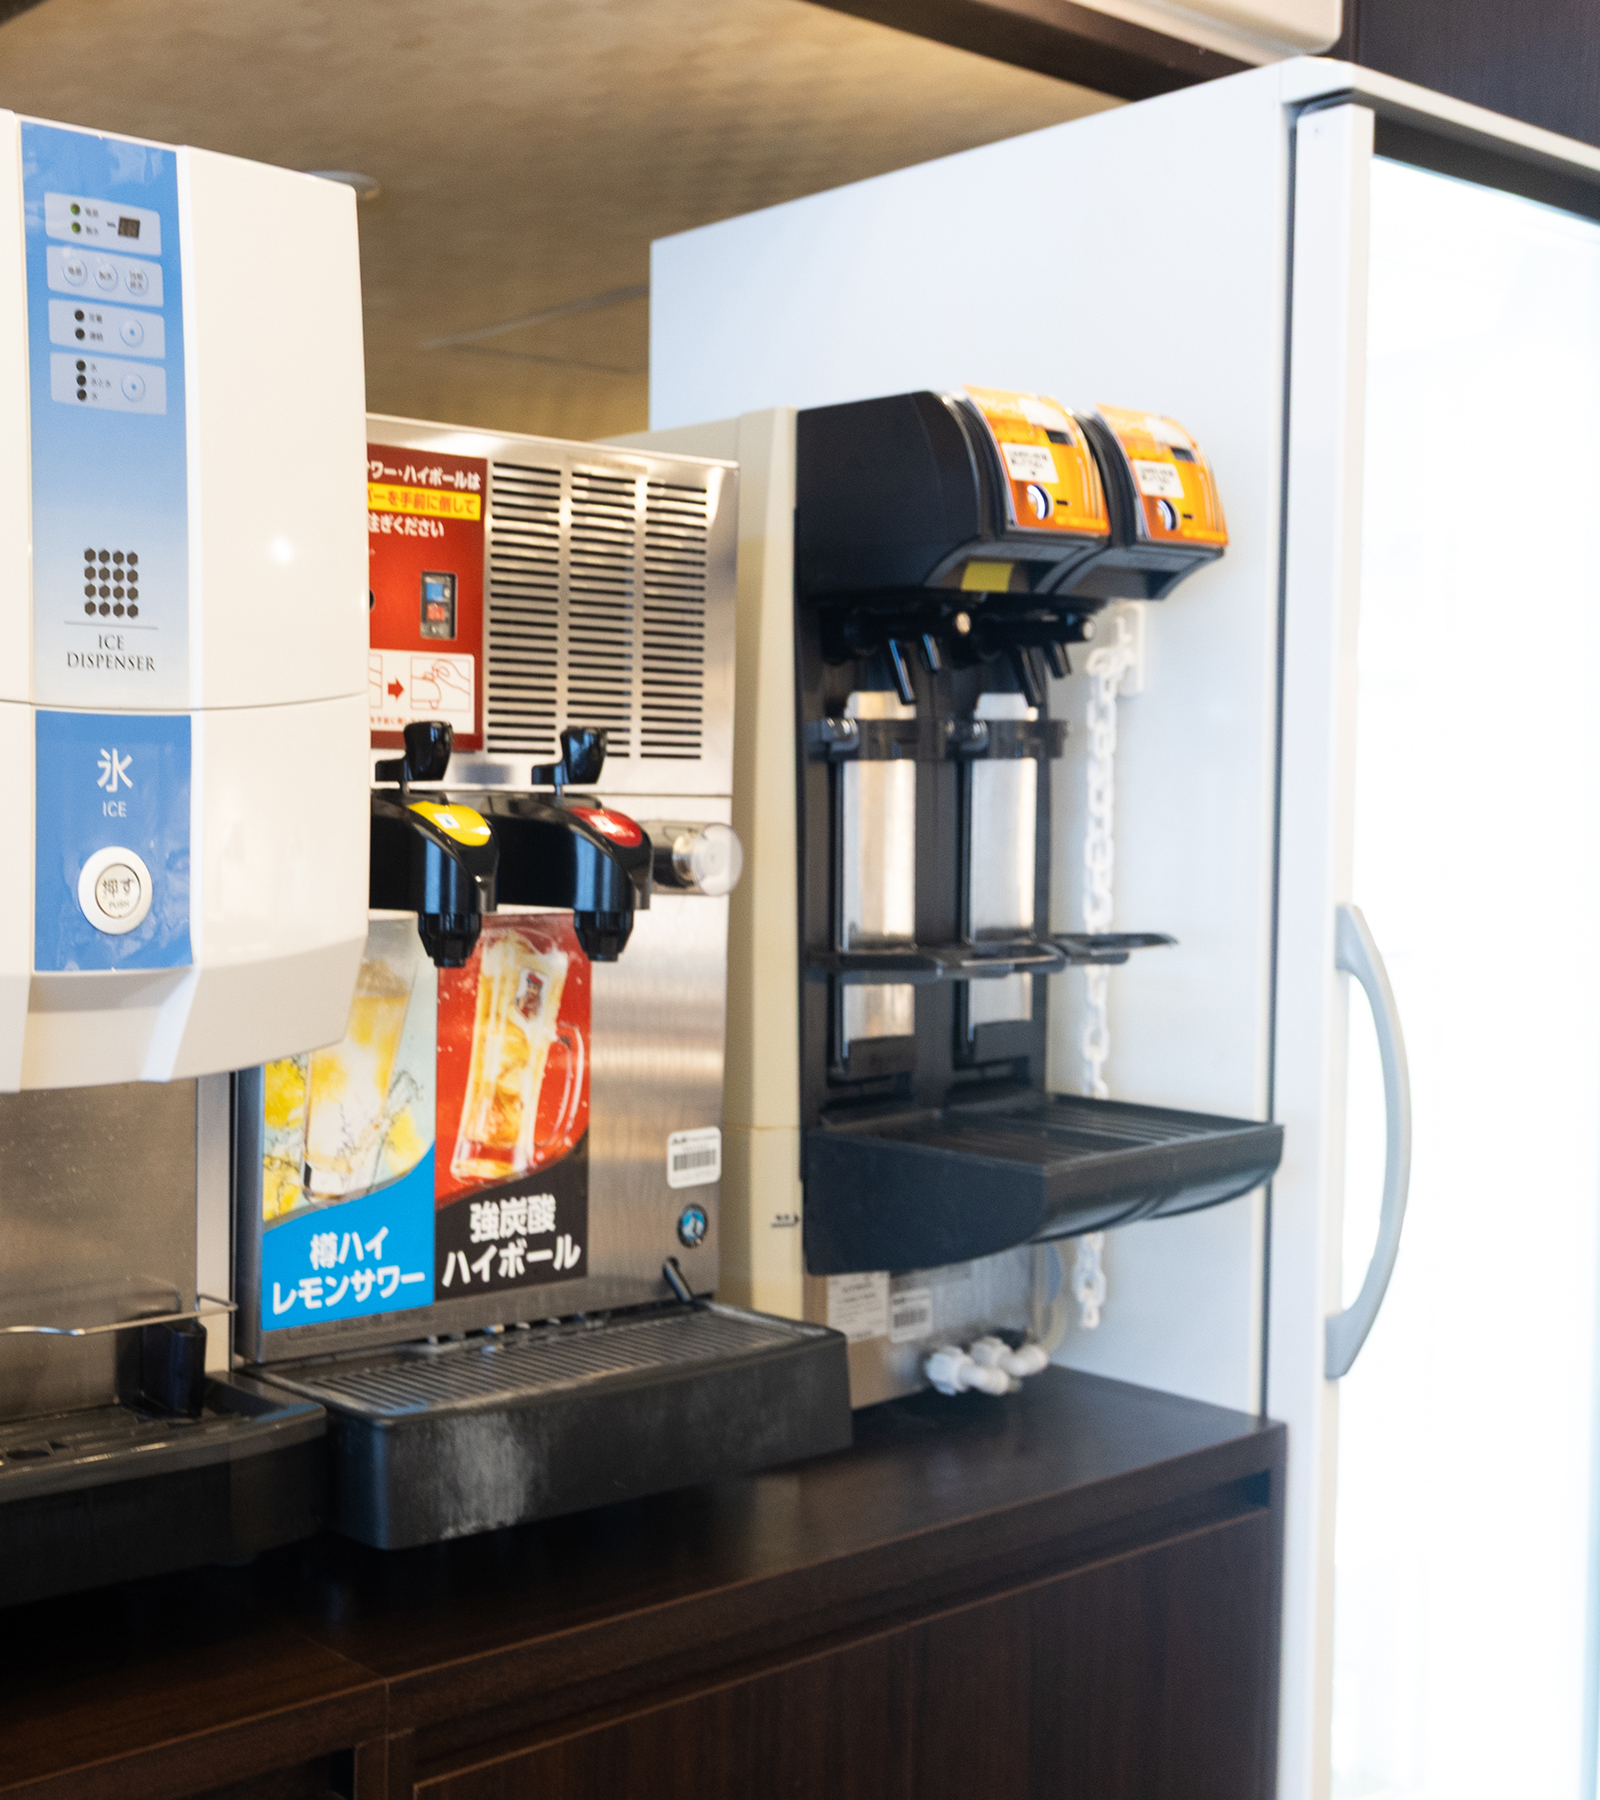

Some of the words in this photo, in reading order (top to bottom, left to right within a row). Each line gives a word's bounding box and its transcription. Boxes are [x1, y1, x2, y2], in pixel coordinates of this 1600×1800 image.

[367, 460, 482, 491] ワー・ハイボールは
[98, 634, 125, 651] ICE
[66, 652, 157, 672] DISPENSER
[96, 747, 134, 793] 氷
[102, 801, 128, 818] ICE
[102, 878, 135, 898] 押す
[470, 1193, 557, 1243] 強炭酸
[310, 1226, 390, 1271] 樽ハイ
[441, 1233, 582, 1288] ハイボール
[272, 1264, 426, 1316] レモンサワー
